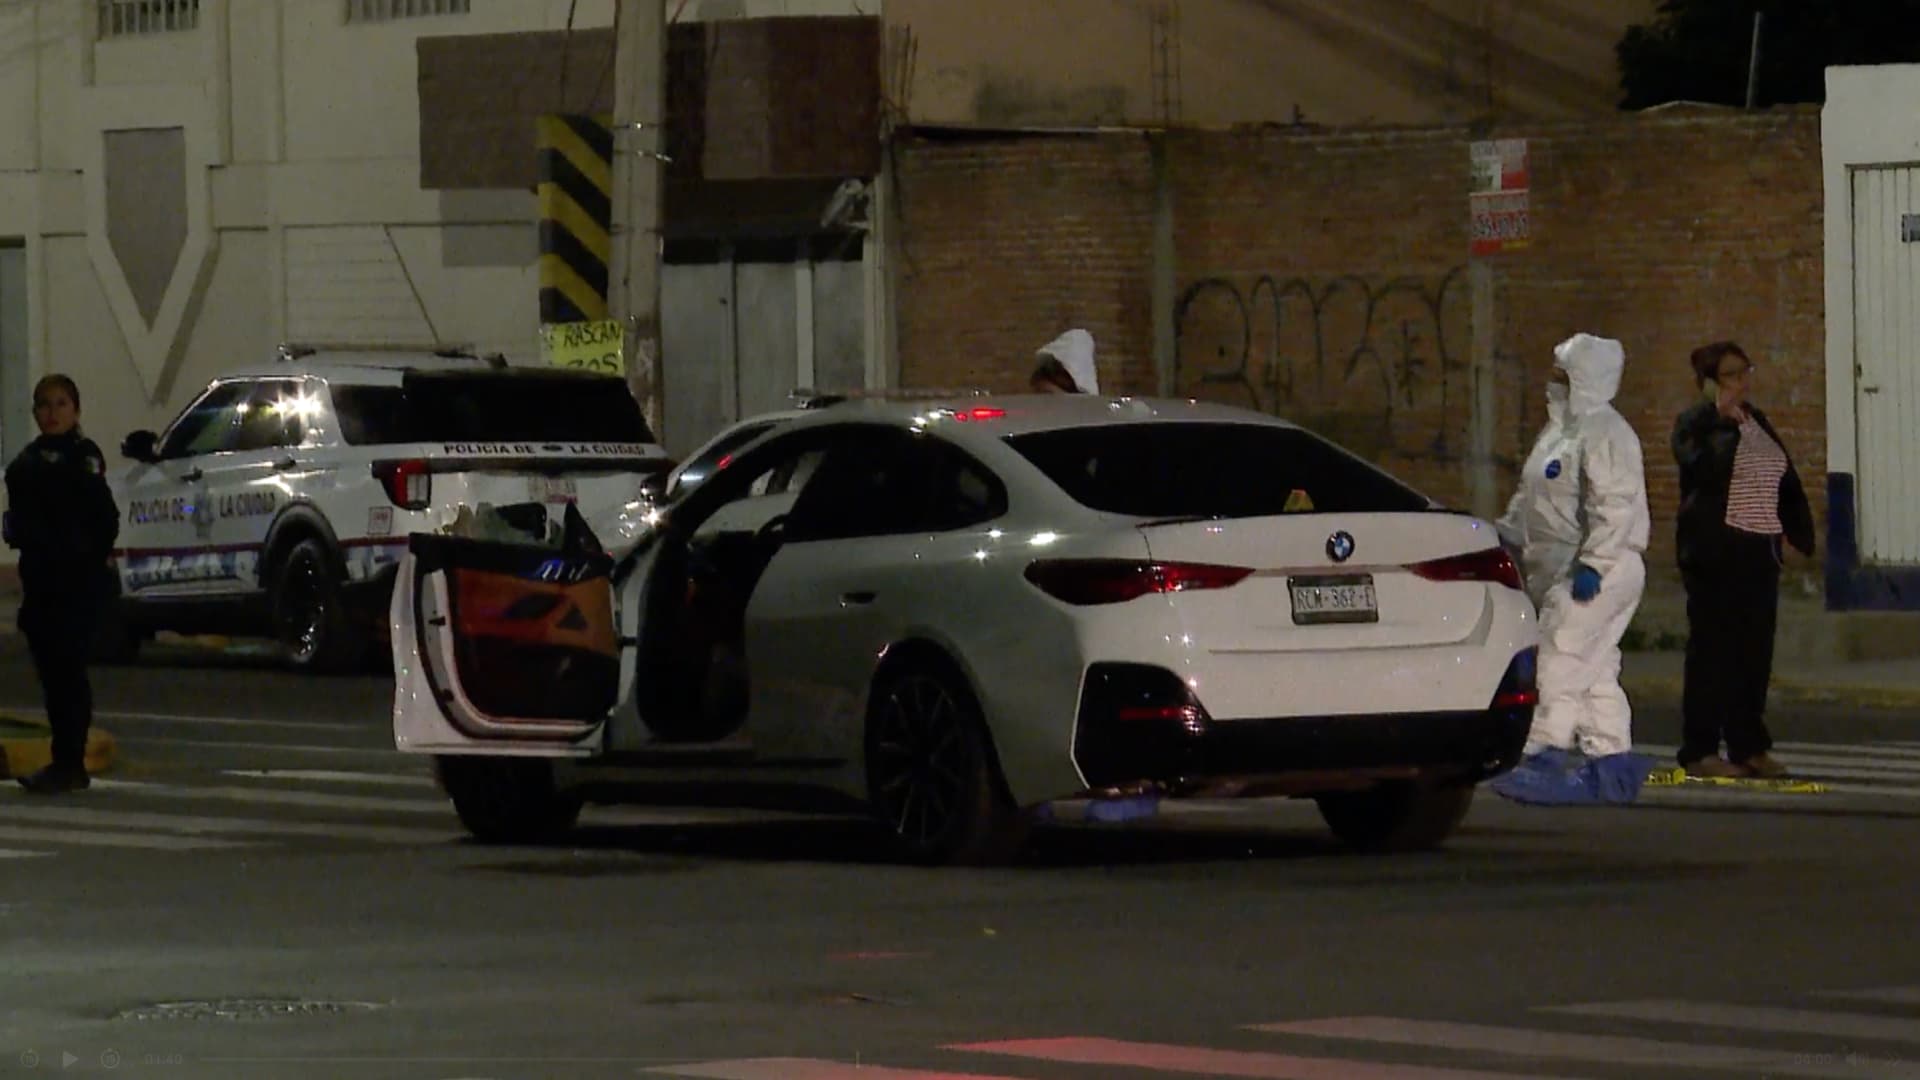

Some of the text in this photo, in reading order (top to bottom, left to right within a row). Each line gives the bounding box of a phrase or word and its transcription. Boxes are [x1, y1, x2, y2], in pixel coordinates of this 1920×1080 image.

[563, 322, 620, 347] RASCAN
[443, 443, 646, 457] POLICIA DE LA CIUDAD
[219, 494, 234, 518] LA
